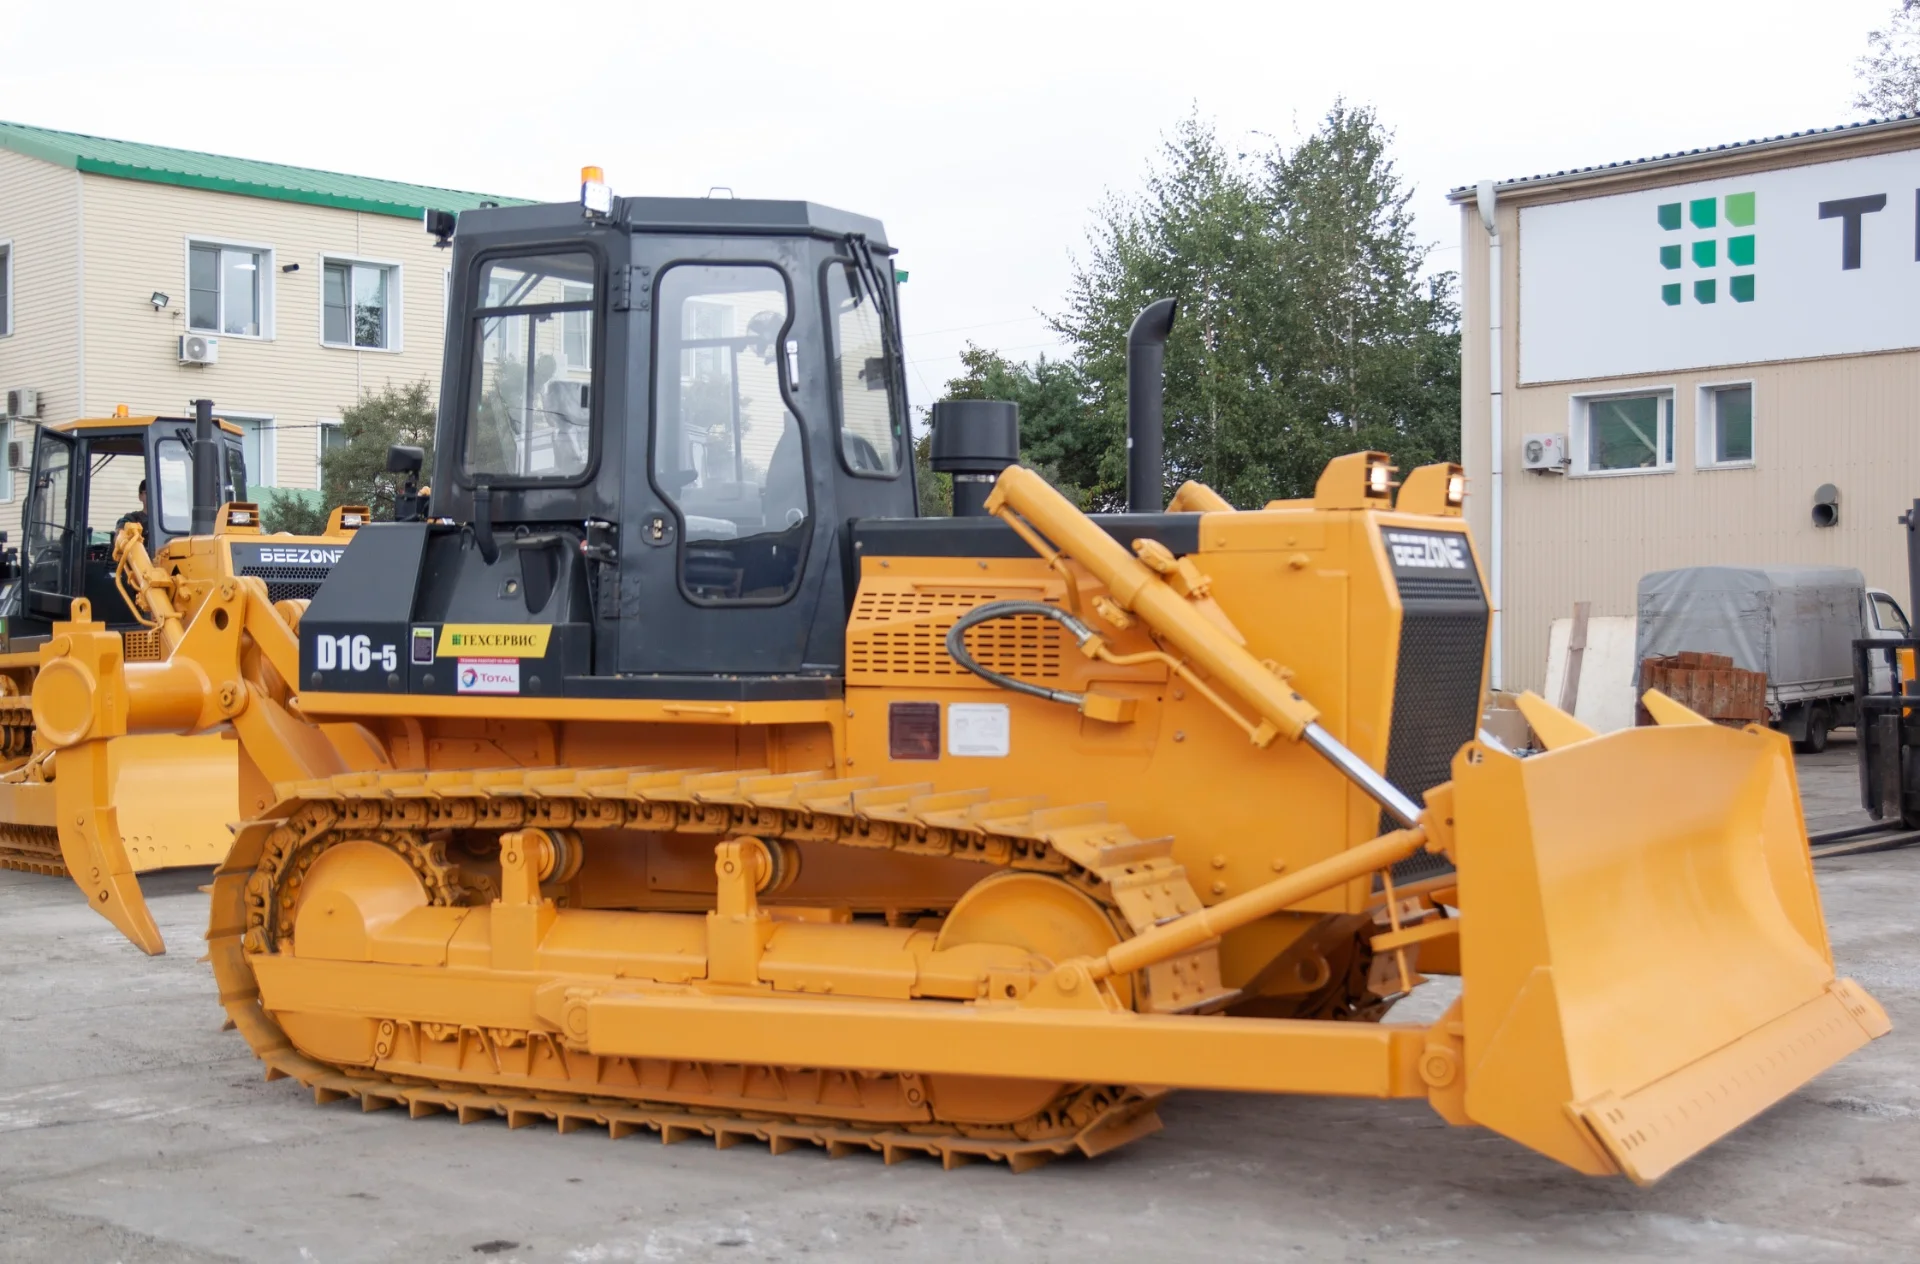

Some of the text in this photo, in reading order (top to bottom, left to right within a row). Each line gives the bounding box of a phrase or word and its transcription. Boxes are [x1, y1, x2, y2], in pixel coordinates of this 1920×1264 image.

[461, 634, 537, 646] ТЕХСЕРВИС
[317, 635, 397, 672] D16-5
[480, 673, 516, 683] TOTAL
